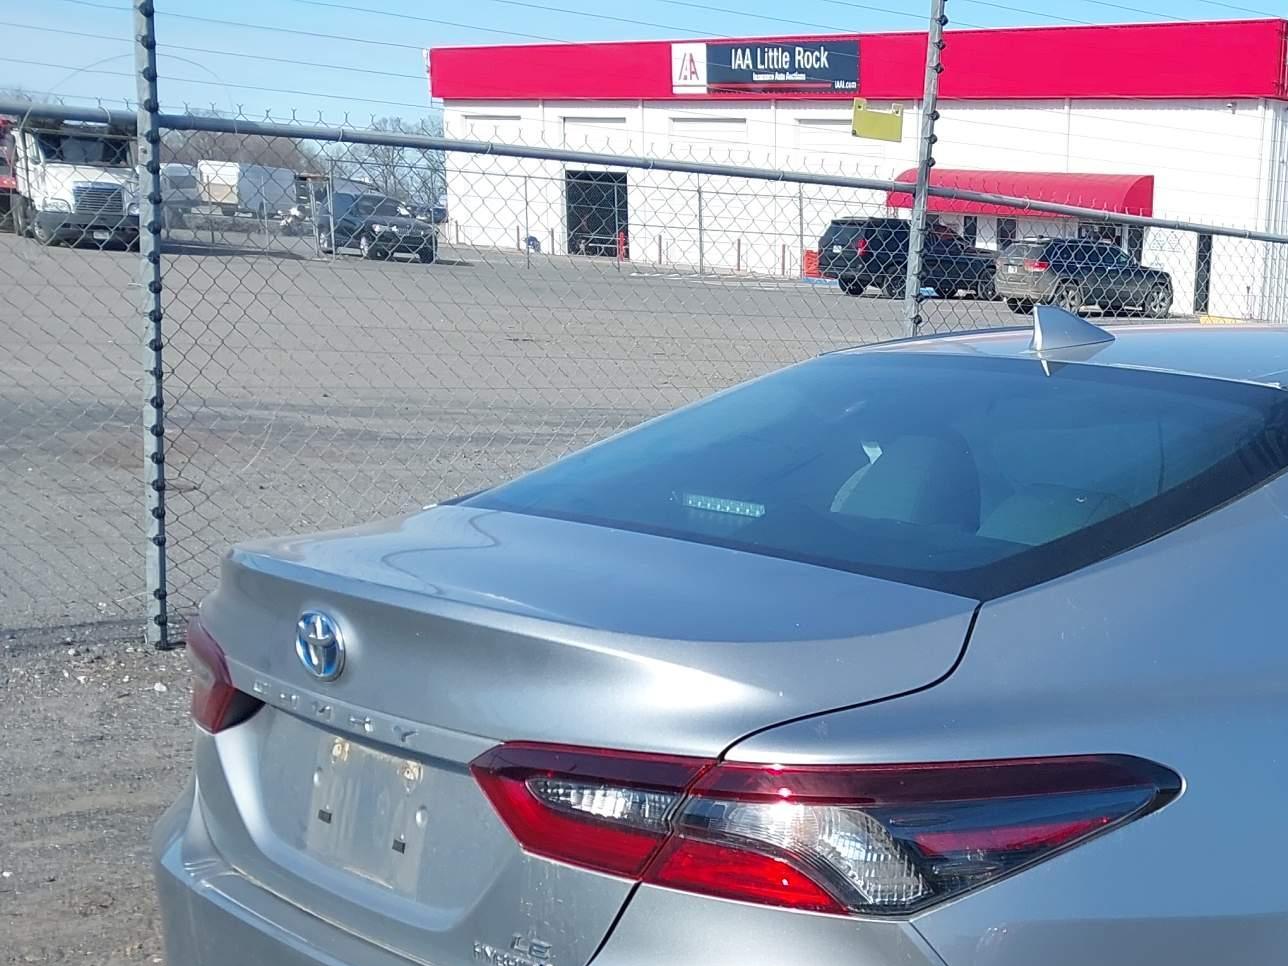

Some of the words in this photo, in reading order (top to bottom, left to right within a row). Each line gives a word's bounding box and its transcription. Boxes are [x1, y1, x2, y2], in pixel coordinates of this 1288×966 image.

[731, 48, 753, 70] IAA
[757, 47, 791, 70] Little
[795, 46, 829, 69] Rock
[775, 72, 785, 81] Auto
[786, 71, 806, 81] Auctions
[253, 680, 418, 742] CAMRY
[510, 932, 553, 960] LE
